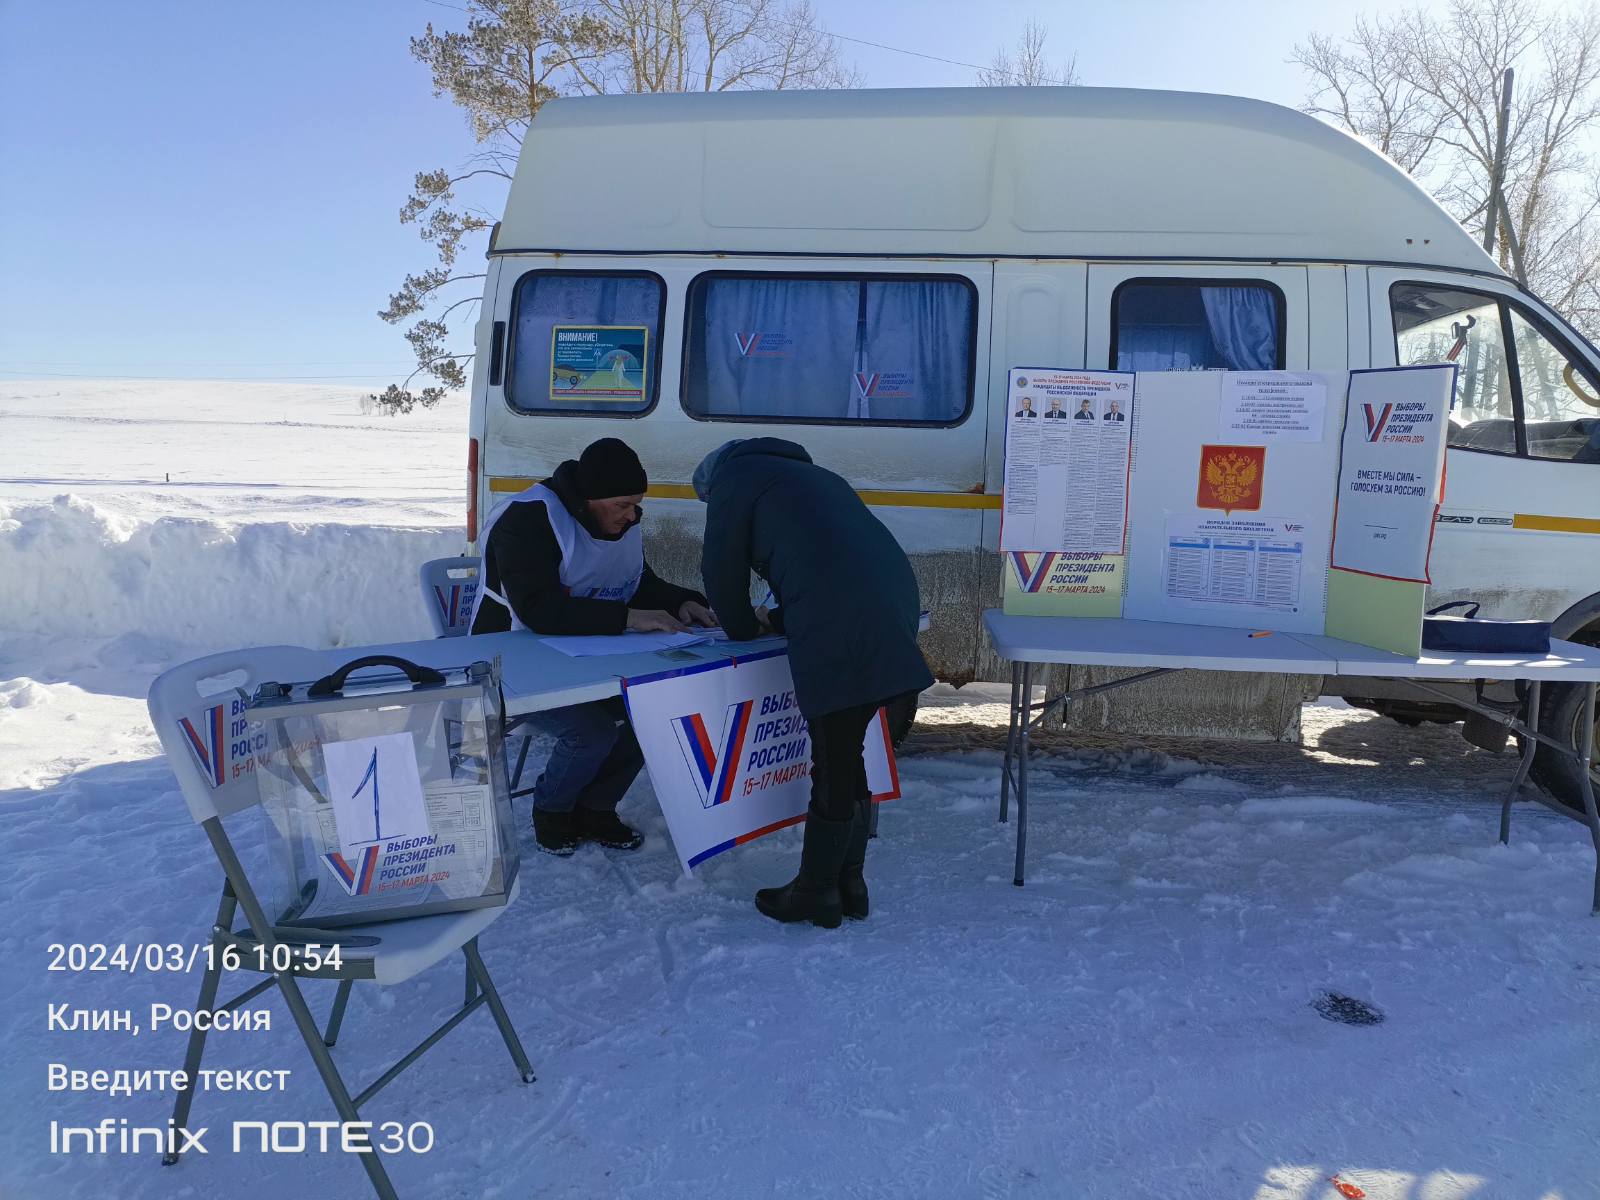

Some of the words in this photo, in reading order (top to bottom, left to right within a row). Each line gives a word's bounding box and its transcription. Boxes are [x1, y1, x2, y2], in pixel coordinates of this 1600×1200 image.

[558, 333, 598, 342] ВНИМАНИЕ!
[1396, 402, 1425, 411] ВЫБОРЫ
[1391, 413, 1433, 423] ПРЕЗИДЕНТА
[1386, 424, 1412, 433] РОССИИ
[1357, 469, 1382, 481] ВМЕСТЕ
[1383, 471, 1395, 482] МЫ
[1396, 472, 1415, 483] СИЛА
[1350, 482, 1383, 494] ГОЛОСУЕМ
[1384, 484, 1393, 494] ЗА
[1393, 485, 1426, 496] РОССИЮ!
[1060, 552, 1103, 561] ВЫБОРЫ
[1055, 563, 1115, 573] ПРЕЗИДЕНТА
[1049, 575, 1089, 584] РОССИИ
[760, 691, 798, 716] ВЫБ
[754, 714, 808, 744] ПРЕЗИД
[747, 737, 807, 772] РОССИИ
[772, 762, 808, 787] МАРТА
[386, 834, 438, 853] ВЫБОРЫ
[383, 843, 456, 866] ПРЕЗИДЕНТА
[380, 862, 426, 881] РОССИИ
[401, 873, 430, 889] МАРТА
[430, 870, 450, 884] 2024
